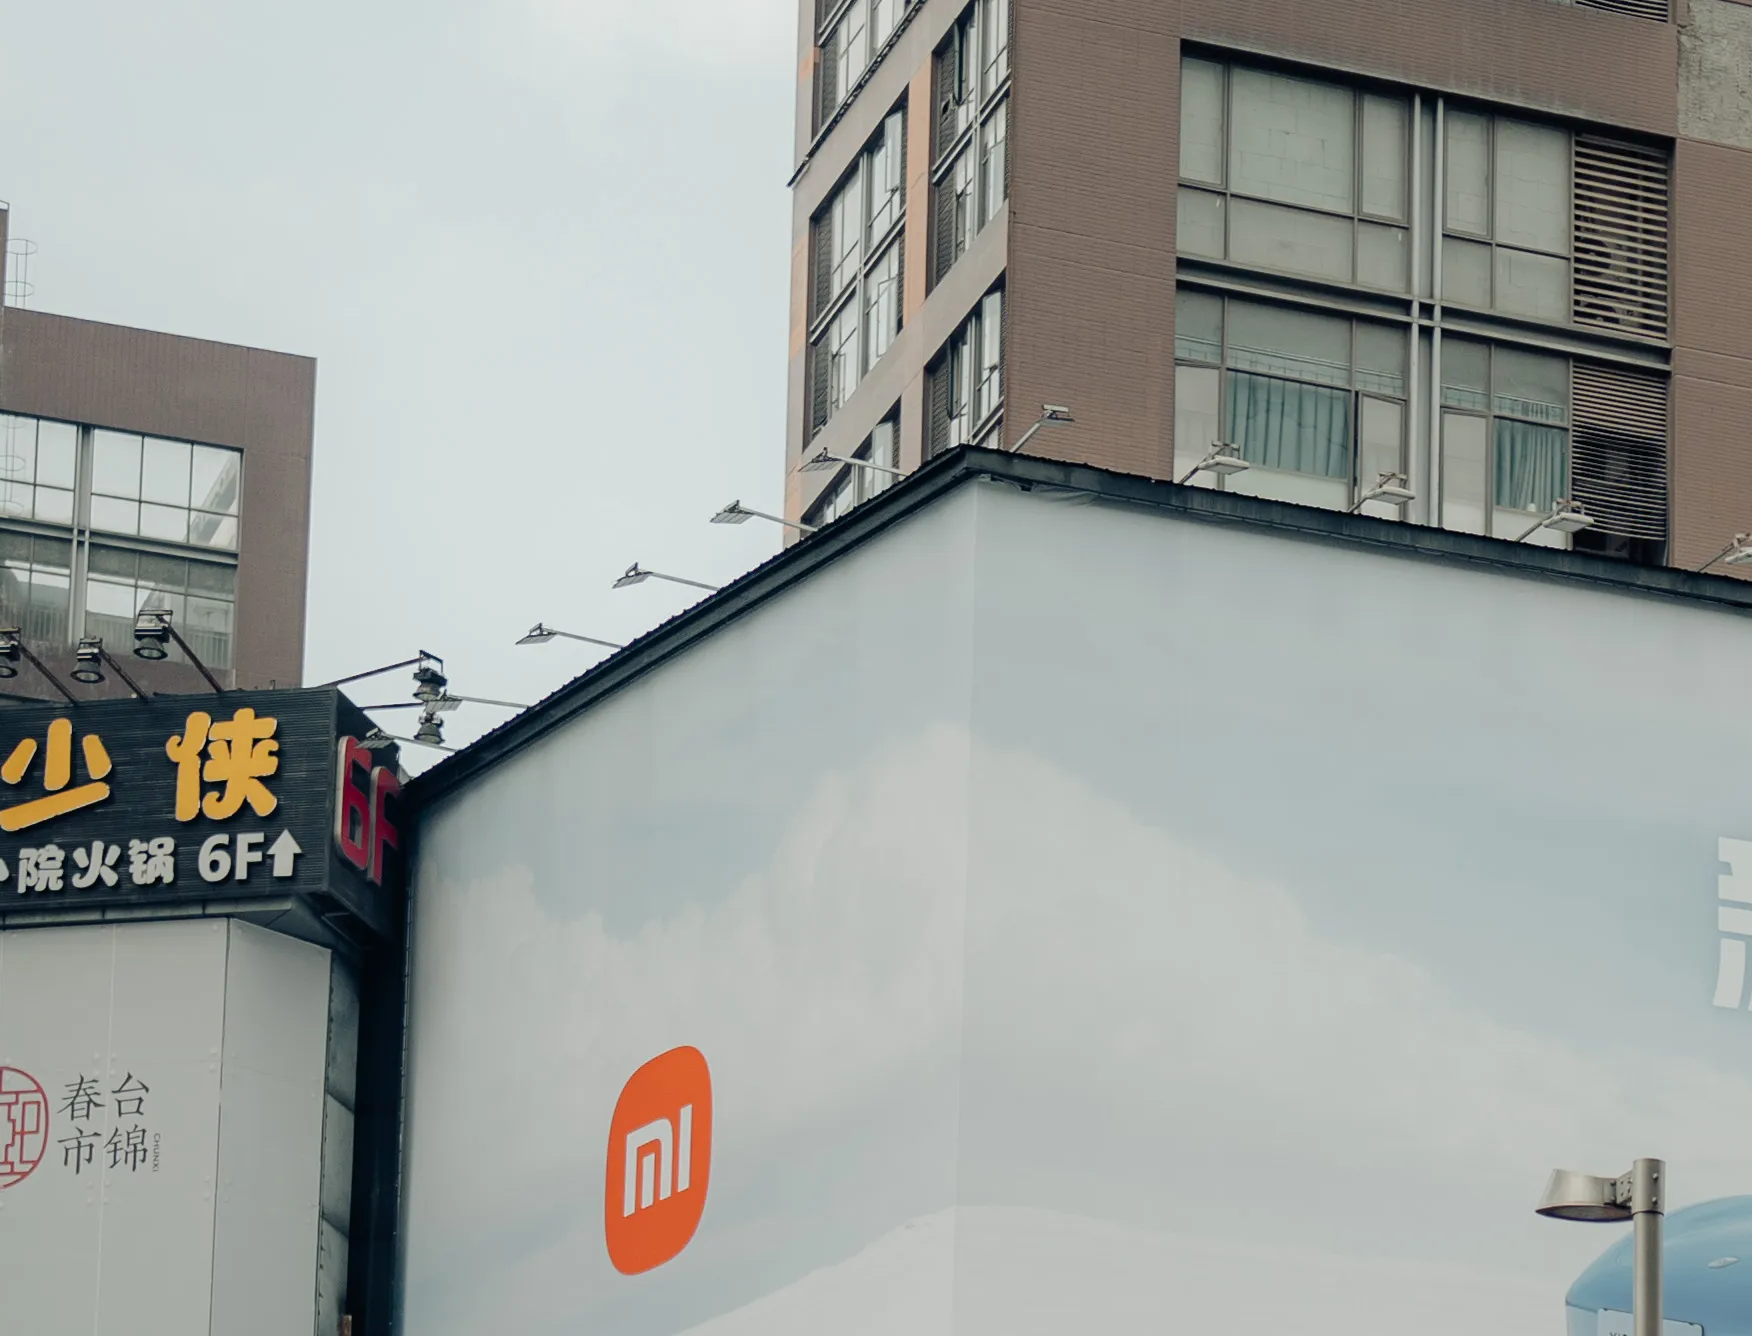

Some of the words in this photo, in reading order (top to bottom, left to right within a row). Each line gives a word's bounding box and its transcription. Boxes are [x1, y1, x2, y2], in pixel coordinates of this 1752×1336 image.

[198, 830, 266, 884] 6F
[56, 1071, 150, 1121] 春台
[56, 1123, 149, 1175] 市锦
